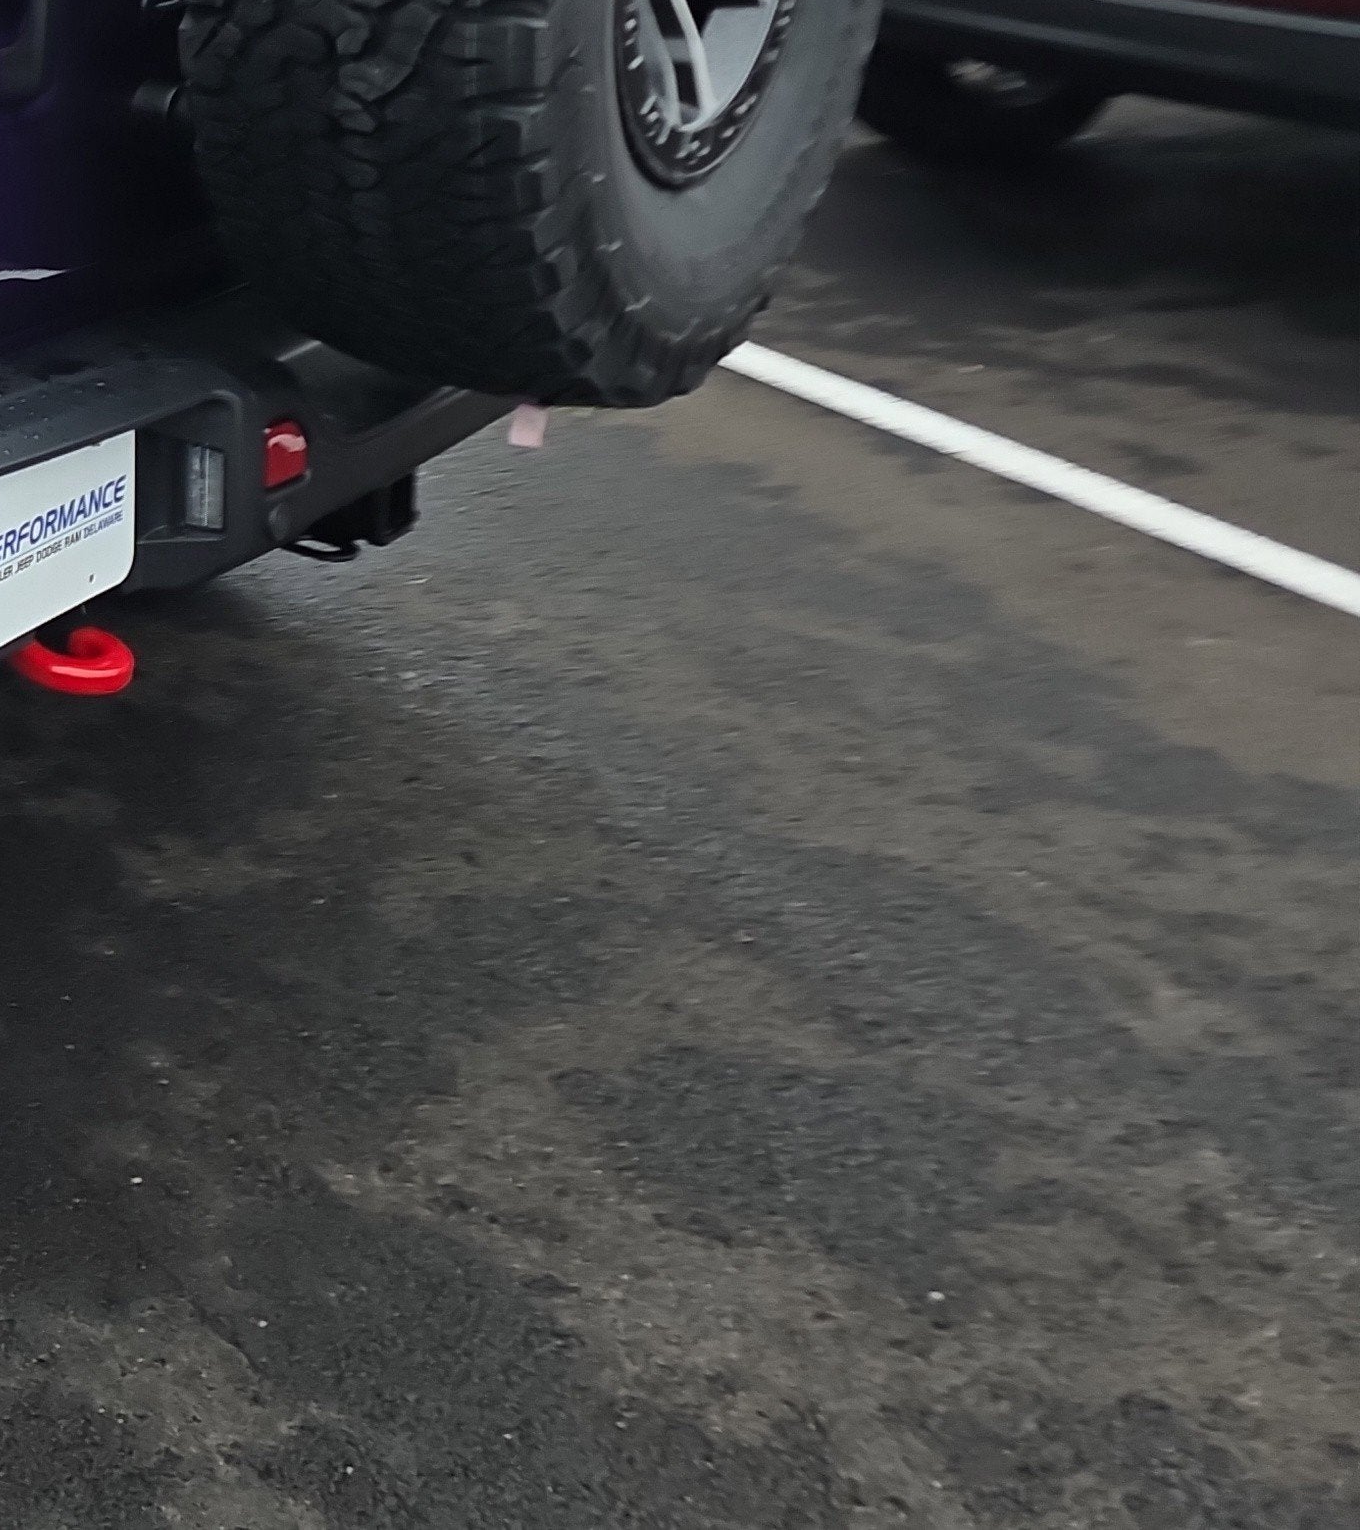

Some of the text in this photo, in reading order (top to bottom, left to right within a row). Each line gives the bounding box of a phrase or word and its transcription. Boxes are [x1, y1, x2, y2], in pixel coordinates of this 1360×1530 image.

[15, 553, 34, 573] JEEP
[36, 540, 62, 563] DODGE
[64, 530, 80, 548] RAM
